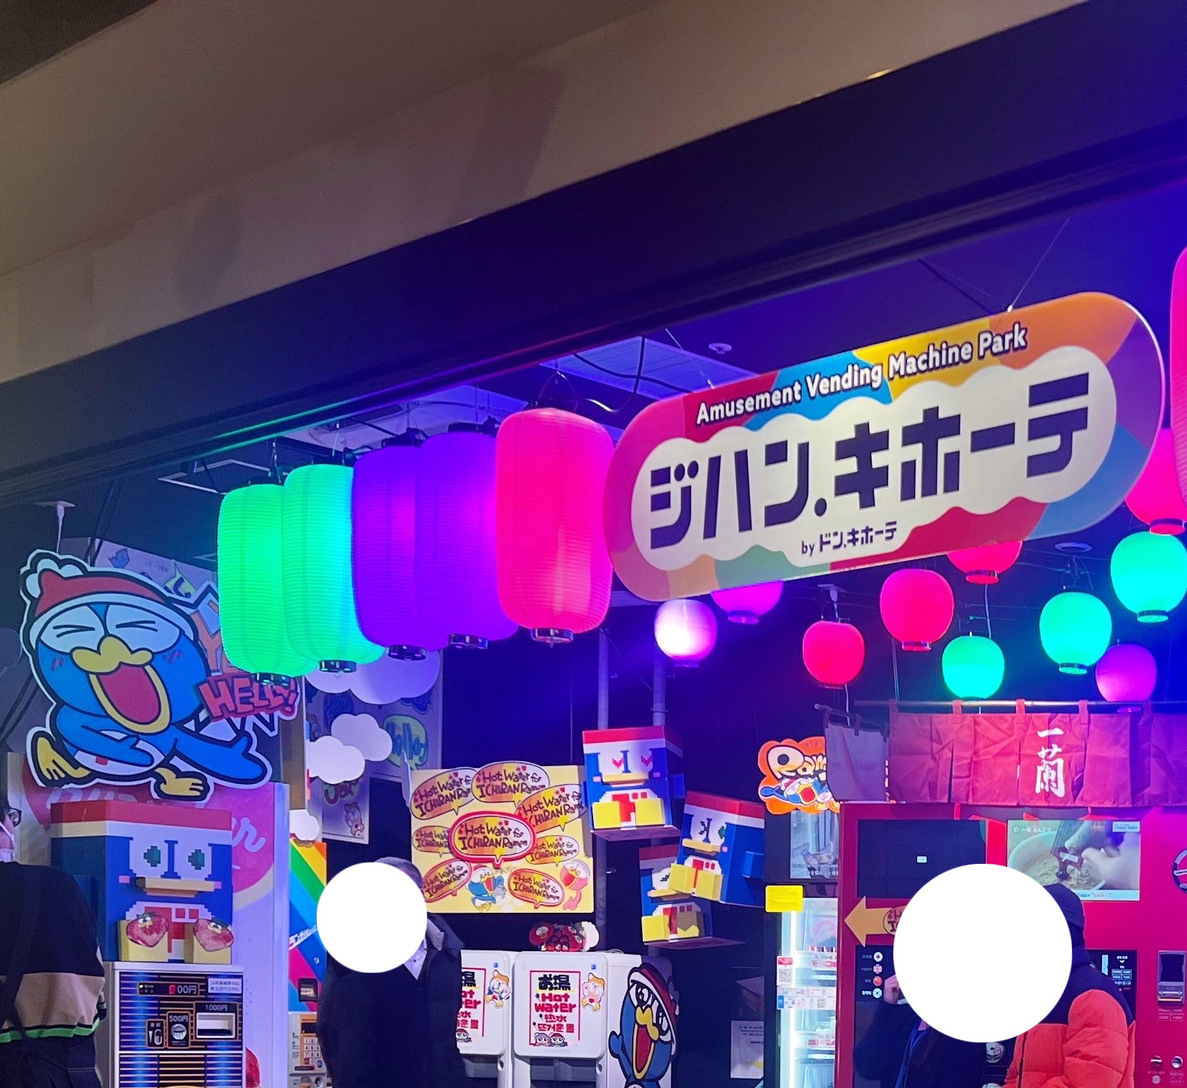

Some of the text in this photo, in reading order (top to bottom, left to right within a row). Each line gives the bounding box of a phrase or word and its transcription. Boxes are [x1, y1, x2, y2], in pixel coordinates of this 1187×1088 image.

[696, 322, 1028, 425] Amusement Vending Machine Park
[649, 372, 1090, 551] ジハン.キホーテ
[801, 541, 816, 556] by
[1035, 727, 1066, 798] 一蘭
[483, 771, 503, 783] Hot
[504, 769, 529, 782] Water
[418, 786, 438, 801] Hot
[437, 778, 463, 792] Water
[476, 784, 520, 799] ICHIRAN
[415, 791, 457, 817] ICHIRAN
[522, 802, 544, 815] Hot
[543, 793, 570, 807] Water
[529, 808, 563, 828] CHIRAN
[465, 822, 524, 839] Hot Water for
[458, 837, 502, 850] ICHIRAN
[502, 837, 527, 849] Ramen
[538, 974, 571, 991] お湯
[541, 993, 570, 1002] Hot
